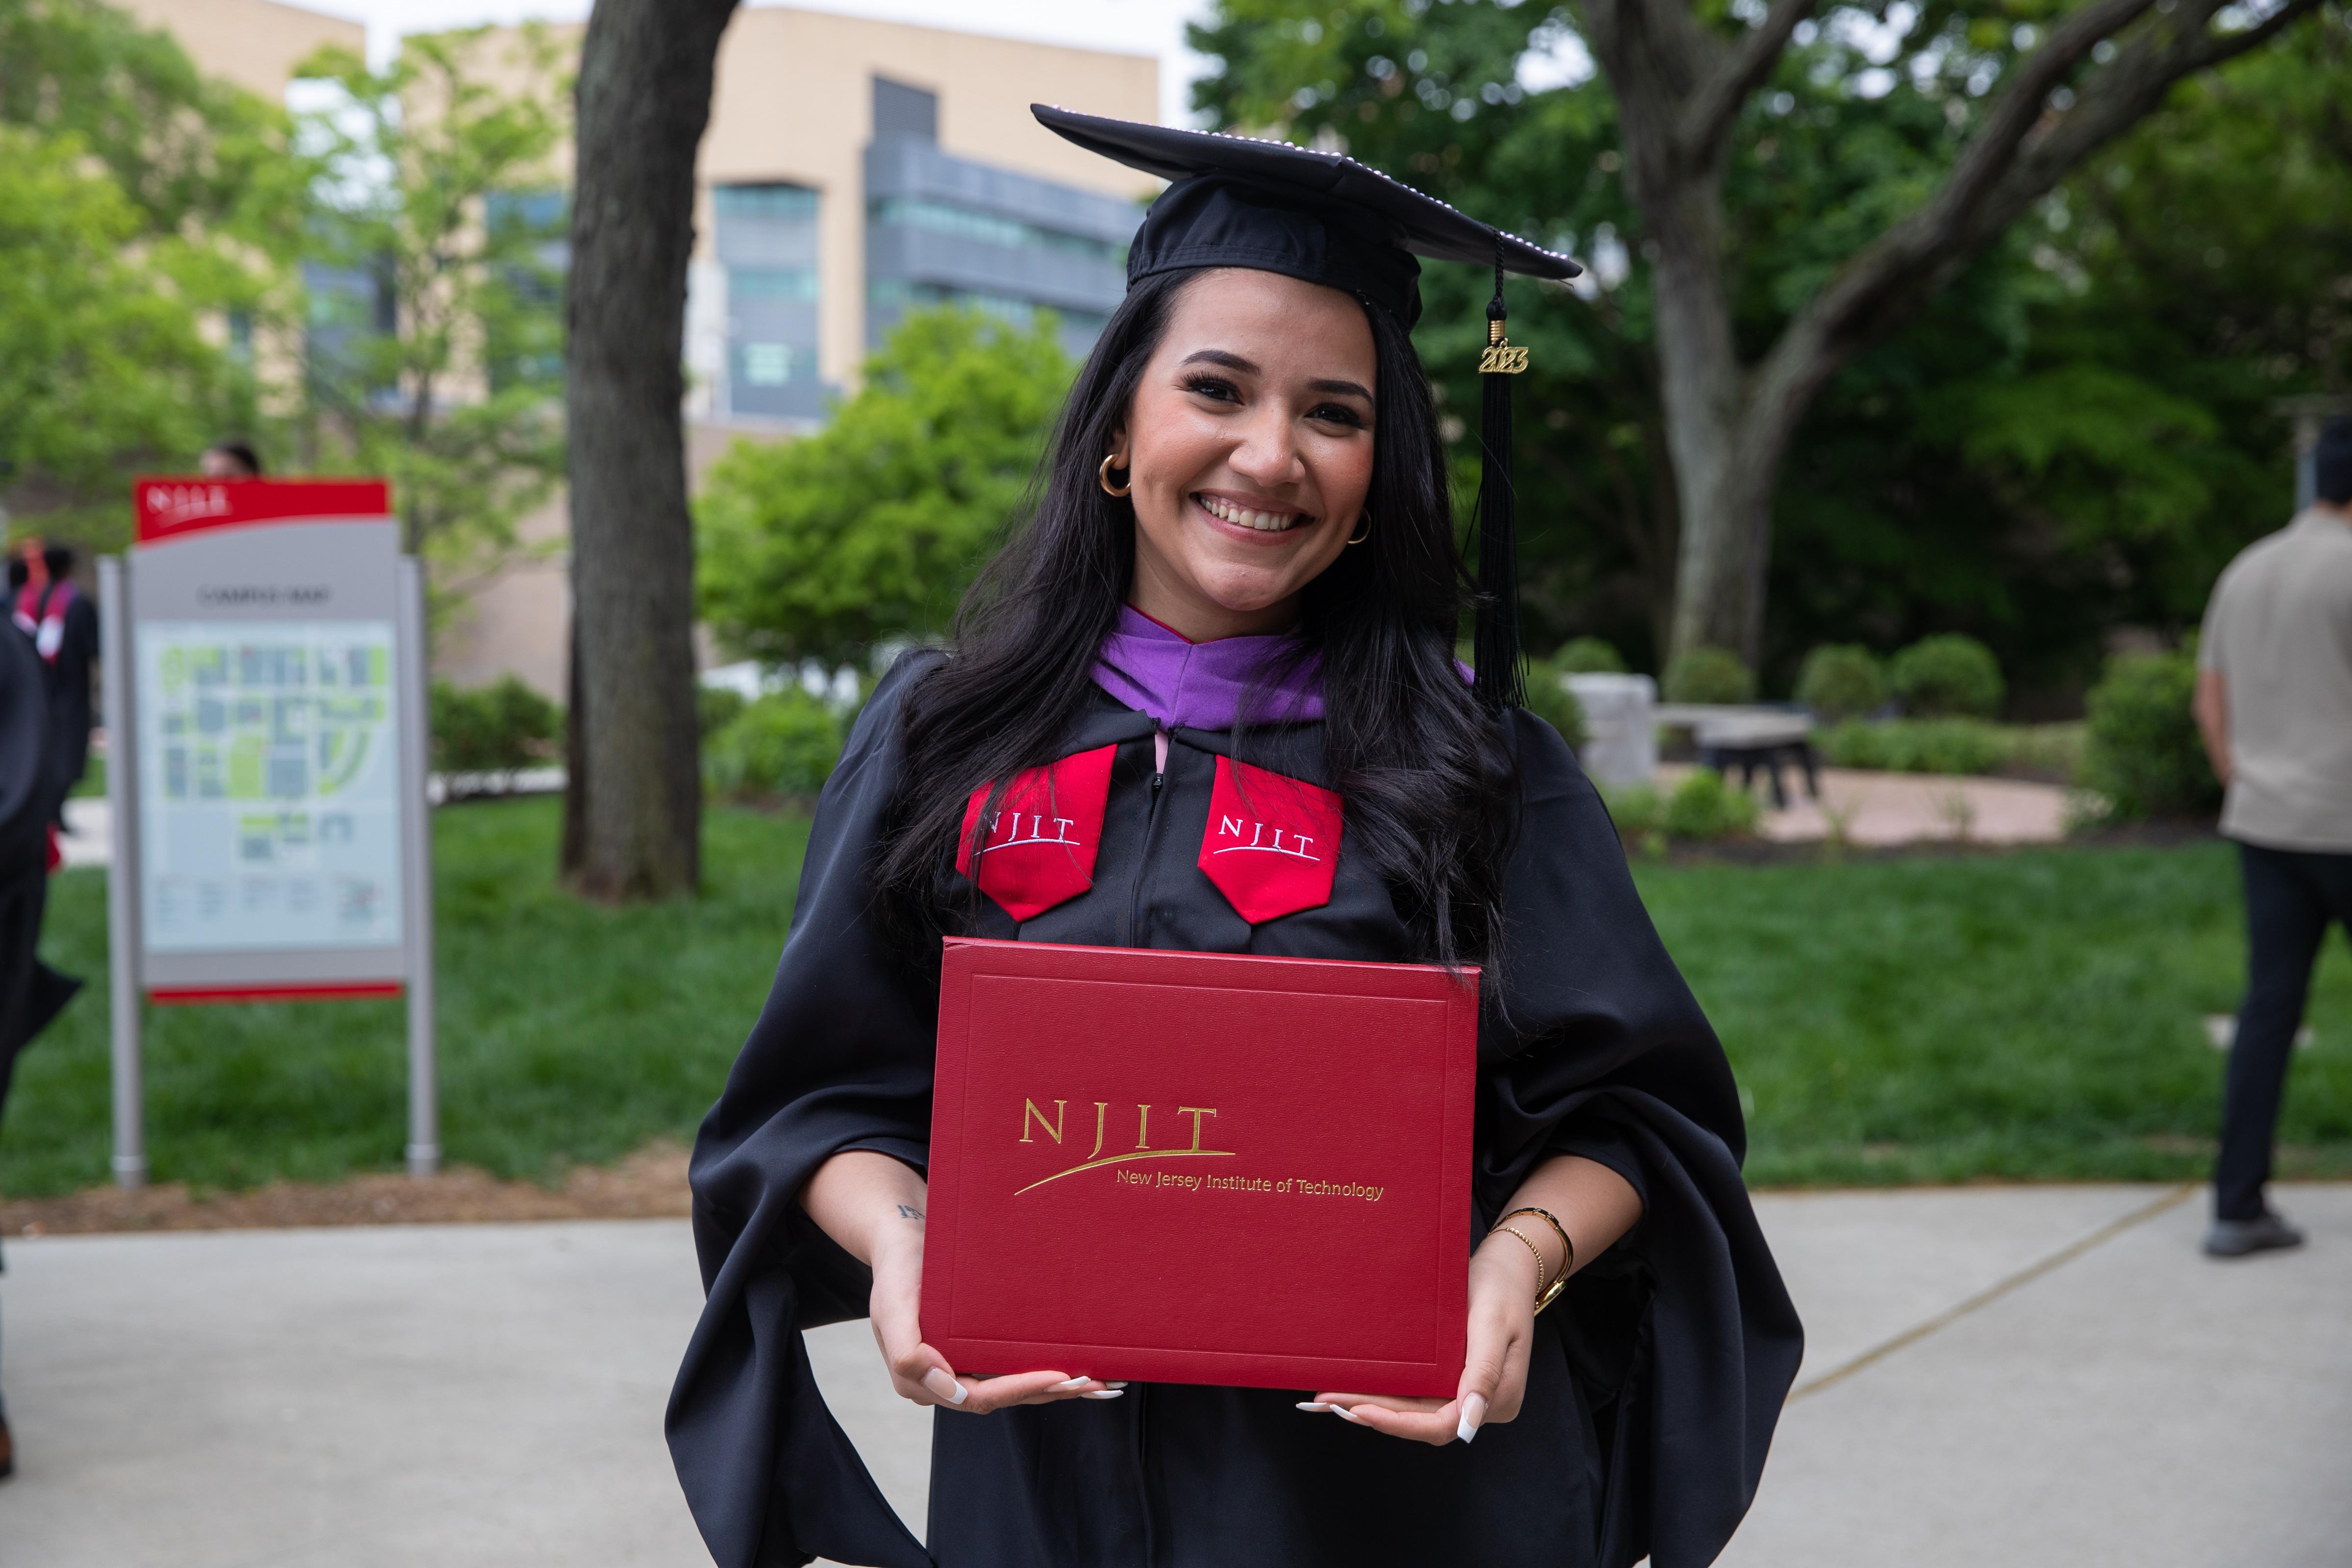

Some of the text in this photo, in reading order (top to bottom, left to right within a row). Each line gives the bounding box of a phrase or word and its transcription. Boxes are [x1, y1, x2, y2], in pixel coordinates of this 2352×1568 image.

[1478, 345, 1529, 374] 2023
[1218, 814, 1314, 855] NJIT
[1019, 1098, 1217, 1159] NJIT
[1117, 1169, 1384, 1201] New Jersey Institute of Technology
